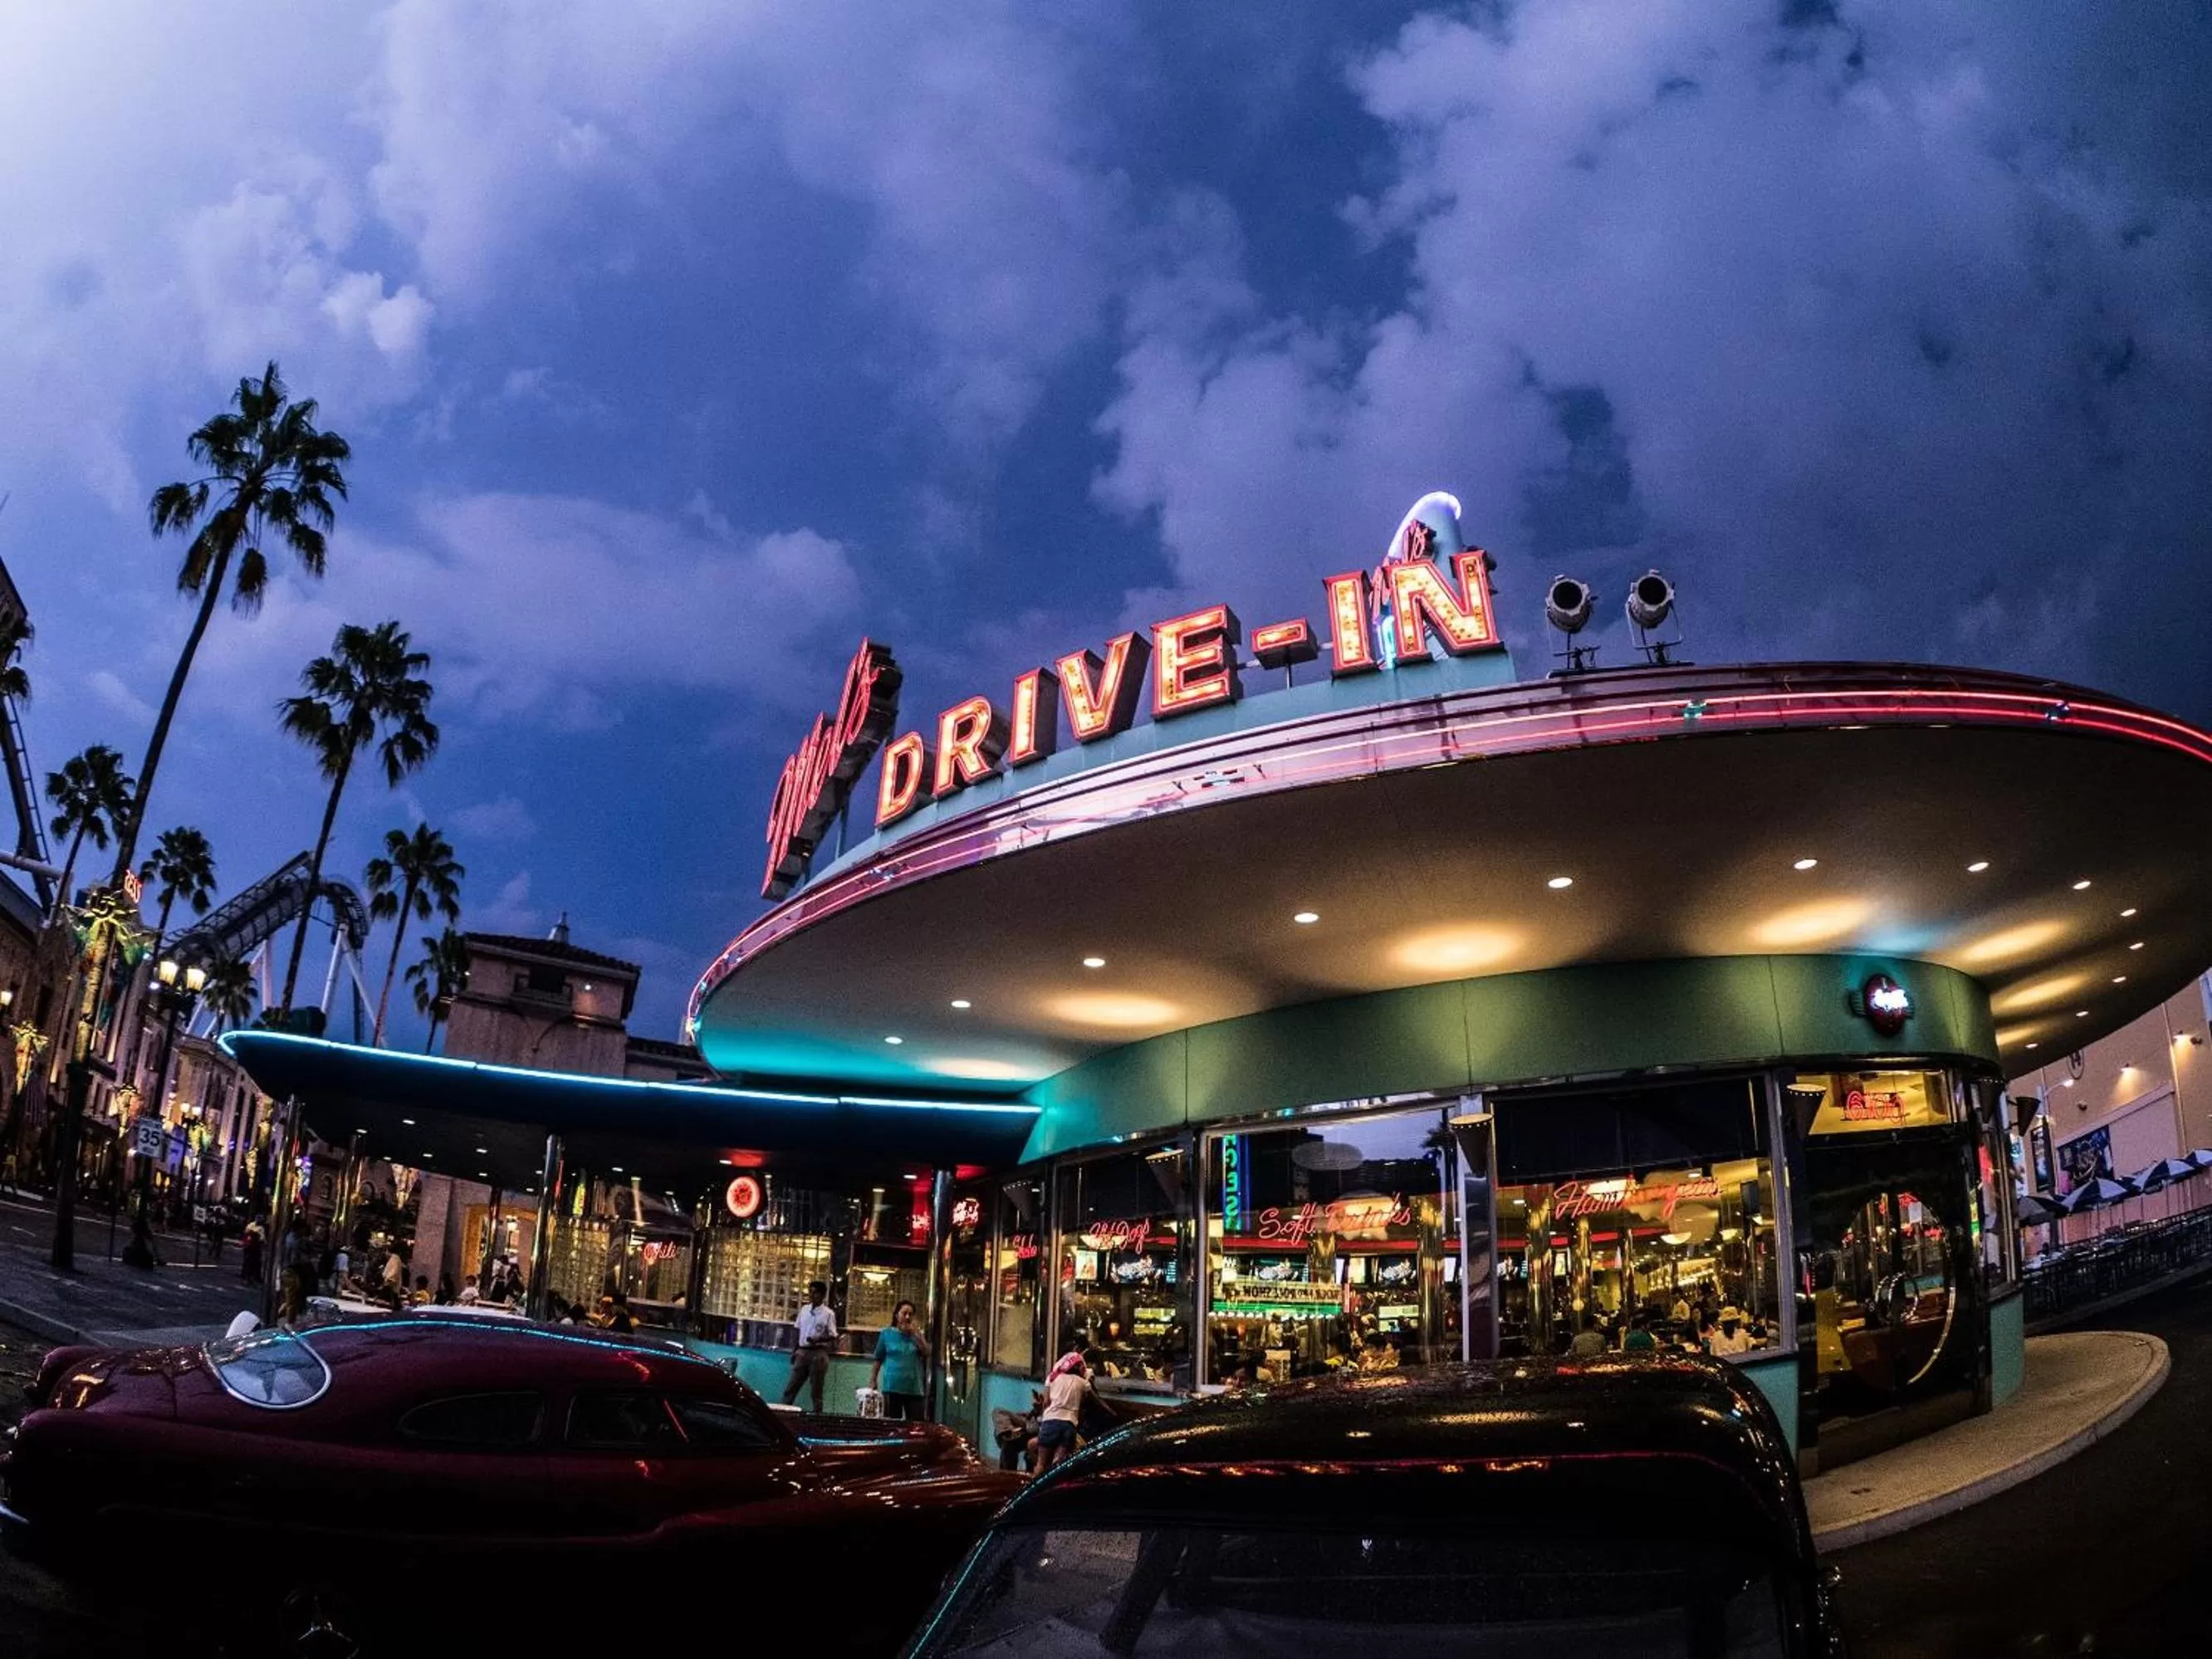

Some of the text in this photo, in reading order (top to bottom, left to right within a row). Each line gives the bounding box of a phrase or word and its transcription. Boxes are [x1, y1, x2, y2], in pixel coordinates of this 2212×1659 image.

[874, 550, 1505, 829] DRIVE-IN
[139, 1128, 160, 1147] 35
[1116, 1217, 1150, 1254] Dogs
[1258, 1192, 1411, 1245] Soft Drinks
